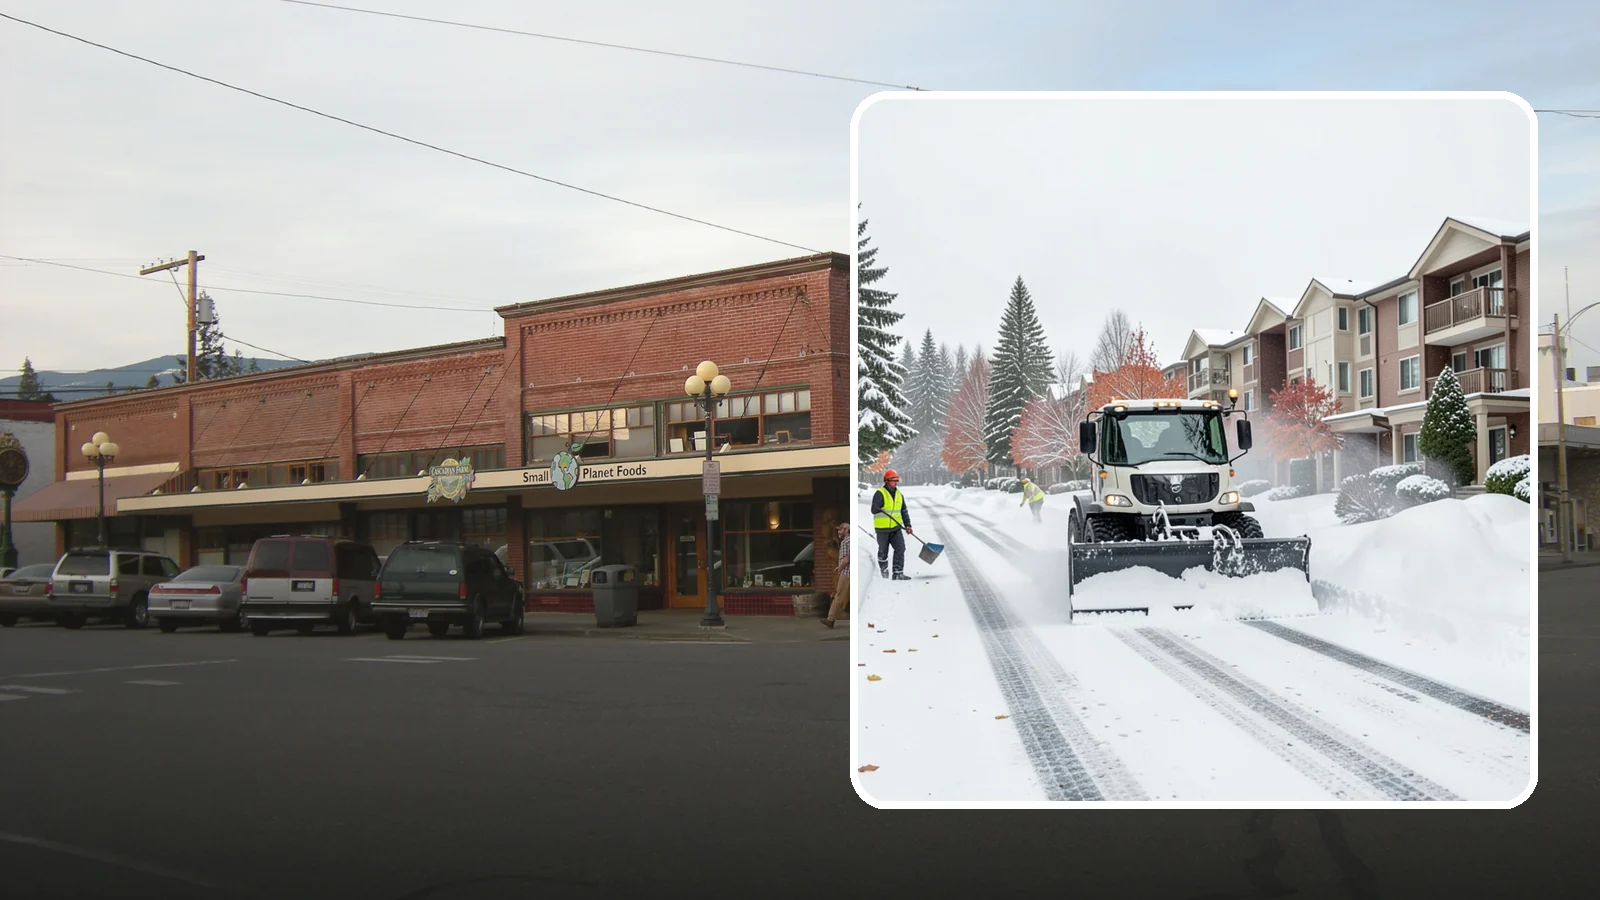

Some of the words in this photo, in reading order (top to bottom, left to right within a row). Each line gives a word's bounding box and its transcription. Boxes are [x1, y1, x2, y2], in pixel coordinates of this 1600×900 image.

[523, 471, 549, 483] Small
[583, 467, 614, 479] Planet
[617, 464, 647, 477] Foods
